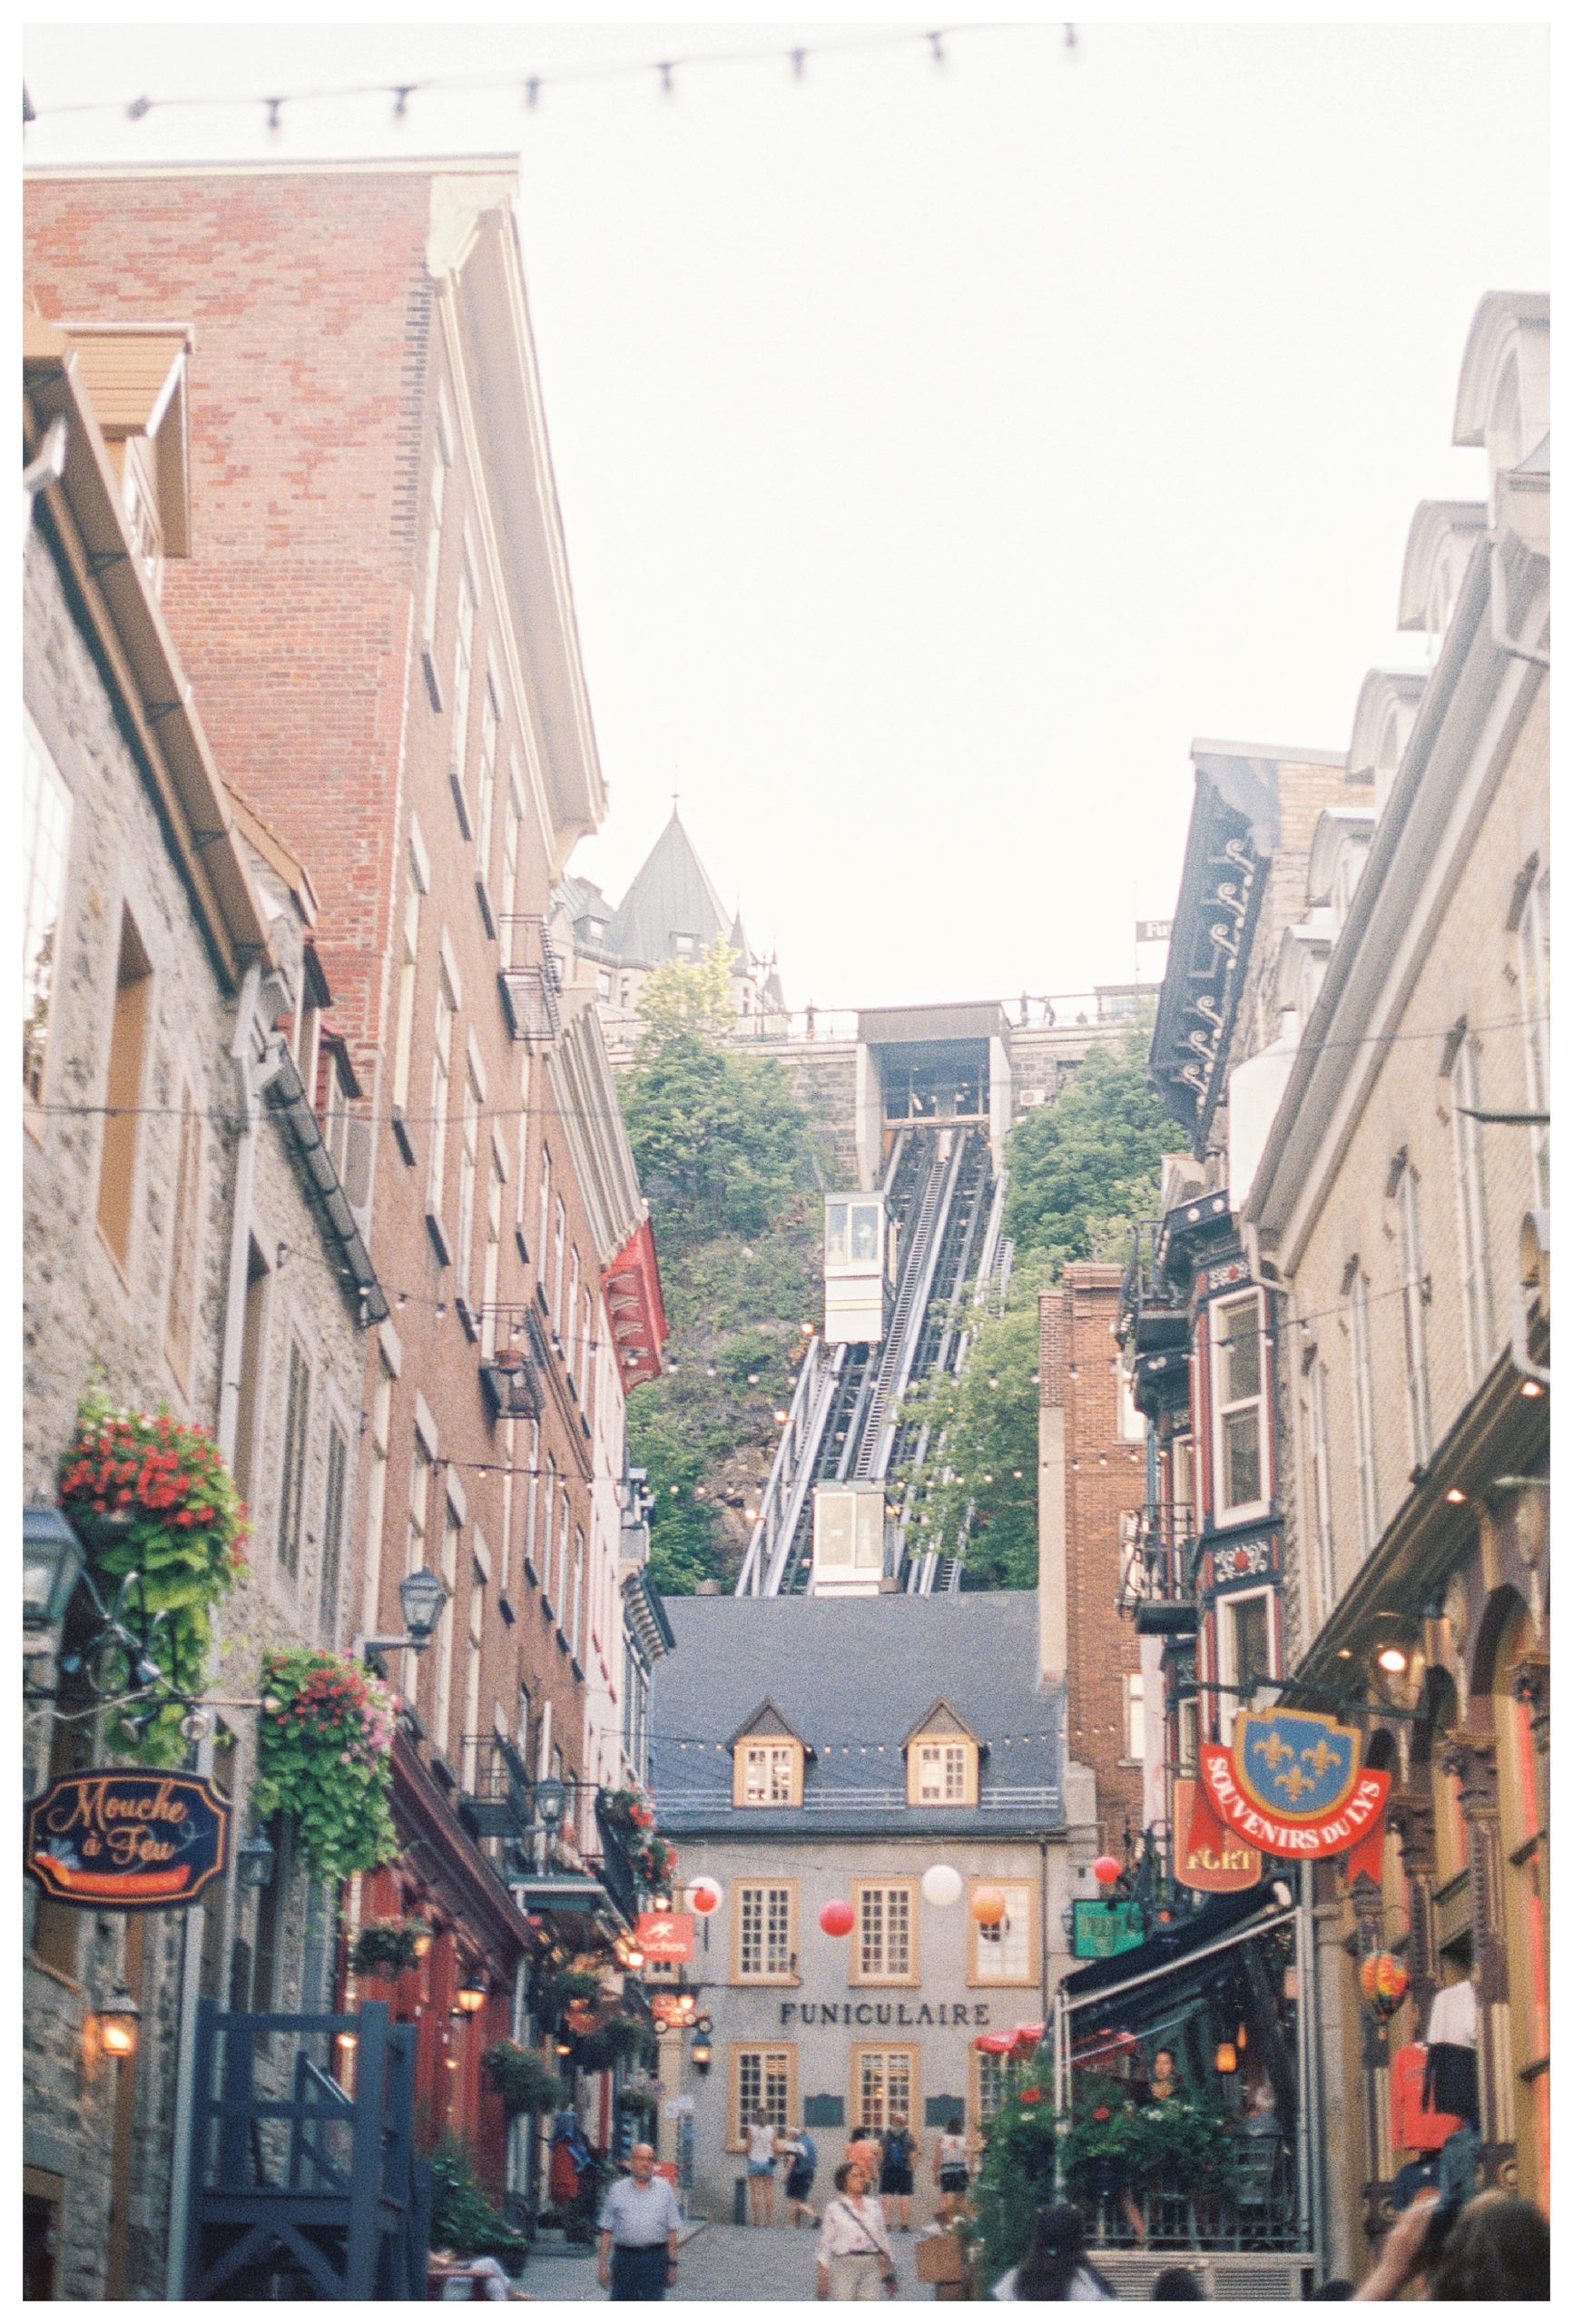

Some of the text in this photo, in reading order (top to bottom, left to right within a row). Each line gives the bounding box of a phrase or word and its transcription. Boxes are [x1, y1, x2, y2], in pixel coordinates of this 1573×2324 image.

[47, 1778, 188, 1832] Mouche
[1208, 1757, 1381, 1848] SOUVENIRS DU LYS
[82, 1826, 175, 1865] à Feu
[781, 2003, 990, 2025] FUNICULAIRE
